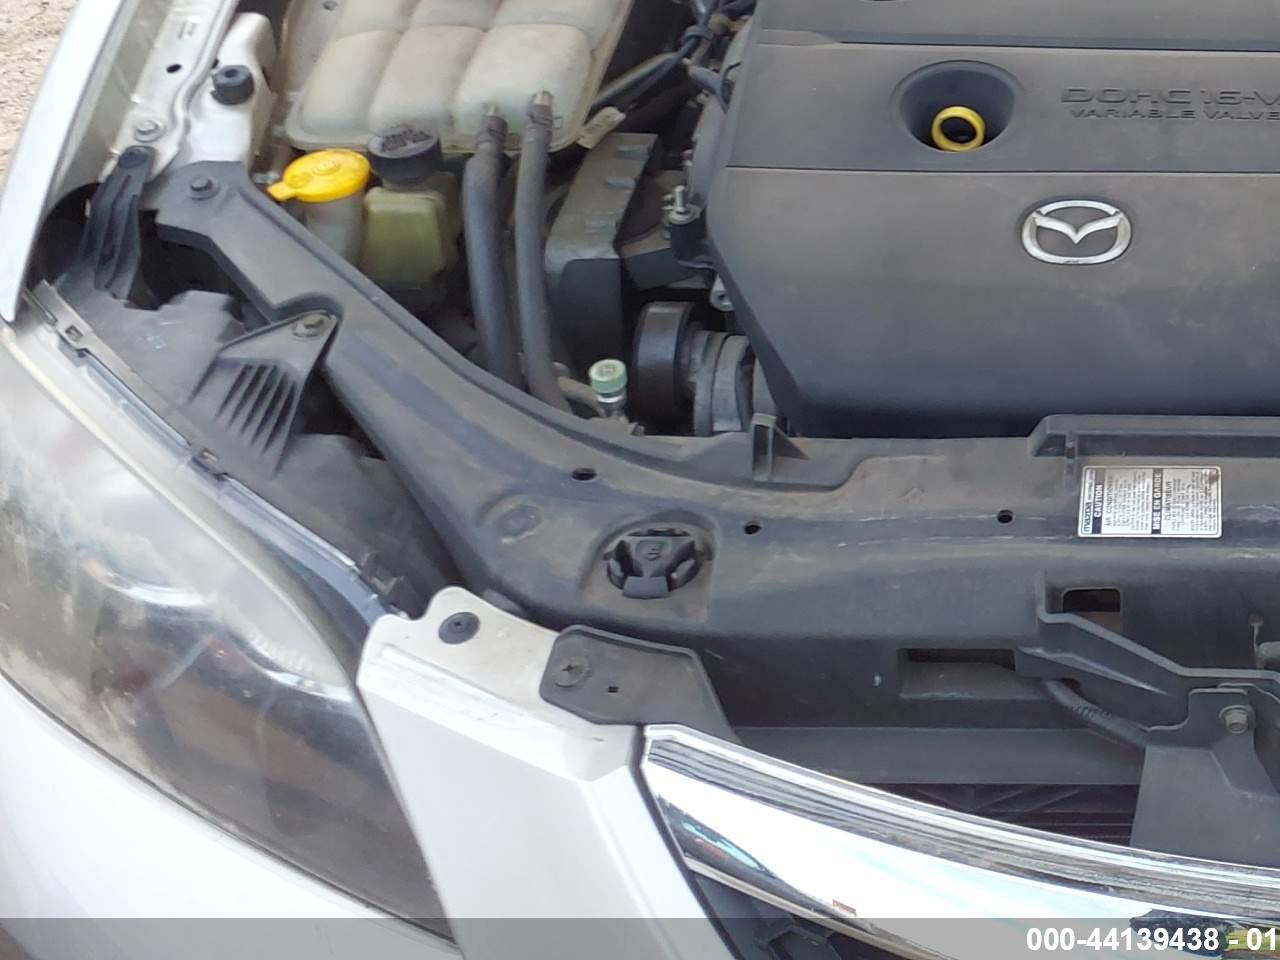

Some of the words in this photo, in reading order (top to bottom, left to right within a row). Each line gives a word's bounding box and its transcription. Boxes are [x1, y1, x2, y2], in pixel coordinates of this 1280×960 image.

[1060, 88, 1192, 104] DOHC
[1072, 108, 1196, 119] VARIABLE
[1203, 109, 1280, 121] VALVE
[1153, 472, 1163, 499] GARDE
[1093, 484, 1104, 518] CAUTION
[1152, 511, 1161, 531] MISE
